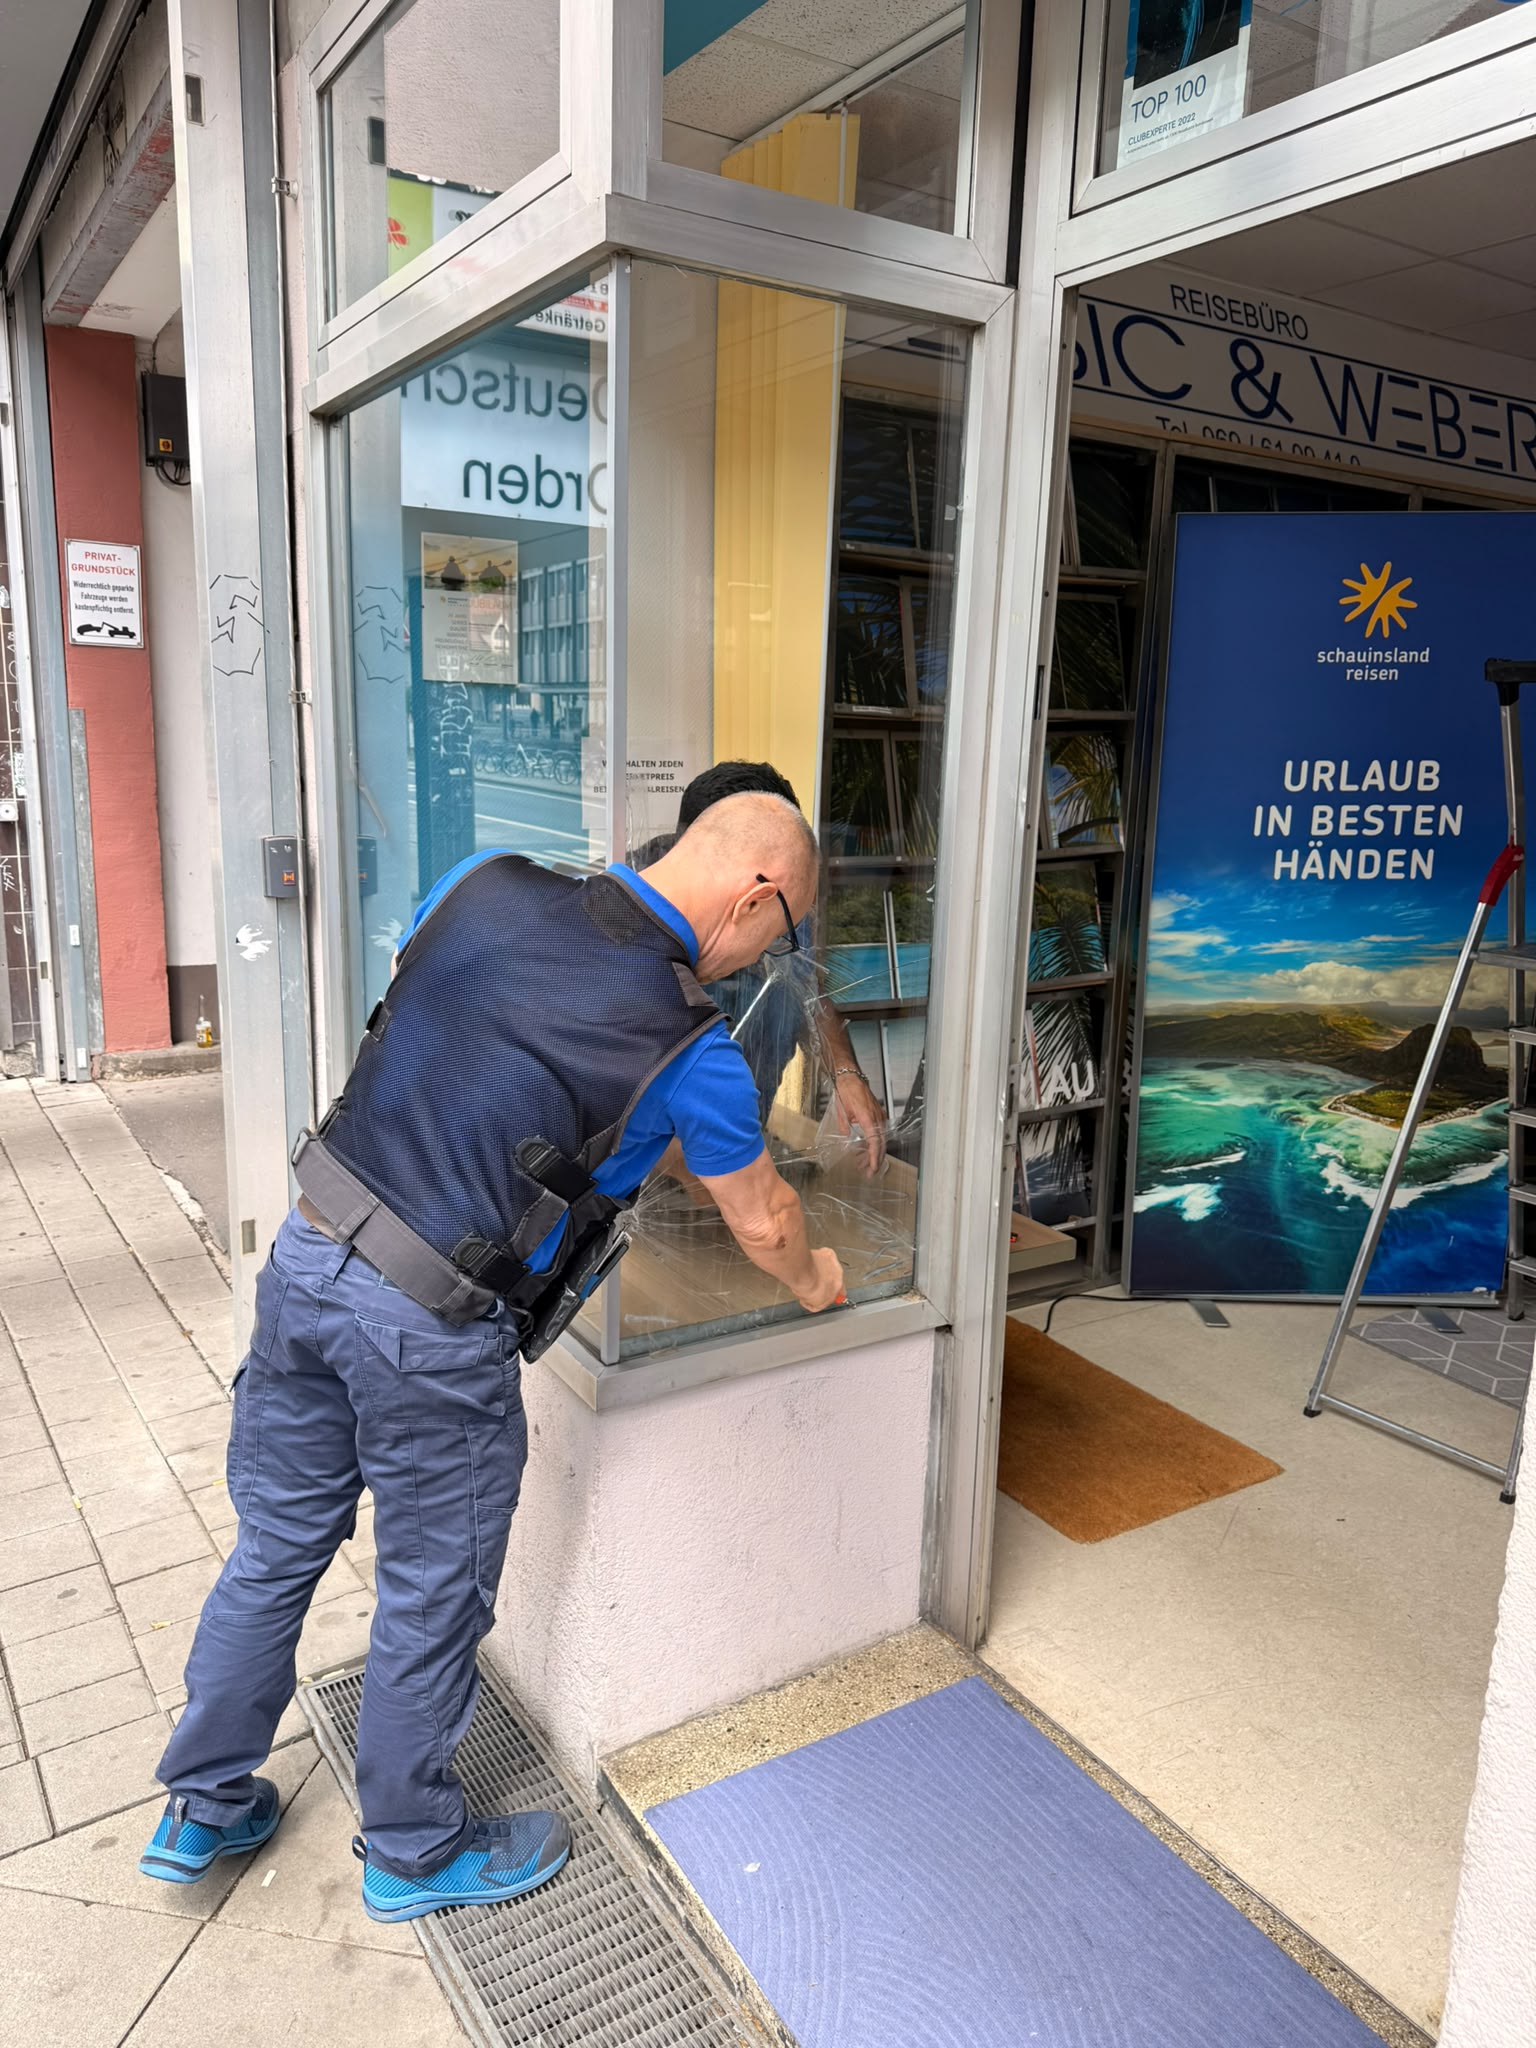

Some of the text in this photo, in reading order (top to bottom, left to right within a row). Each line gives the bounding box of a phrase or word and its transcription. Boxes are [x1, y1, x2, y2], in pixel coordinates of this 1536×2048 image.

[1131, 74, 1207, 123] TOP 100
[1128, 120, 1176, 146] CLUBEXPERTE
[1178, 112, 1196, 126] 2022
[1170, 284, 1309, 341] REISEBÜRO
[1073, 303, 1536, 473] IC & WEBER
[84, 551, 122, 562] PRIVAT-
[71, 563, 136, 577] GRUNDSTÜCK
[73, 580, 135, 593] Widerrechtlich geparkte
[81, 592, 129, 603] Fahrzeuge werden
[75, 602, 113, 614] kostenpflichtig
[1317, 647, 1430, 663] schauinsland
[1346, 665, 1399, 681] reisen
[626, 760, 684, 768] HALTEN JEDEN
[1283, 759, 1440, 792] URLAUB
[1253, 804, 1464, 837] IN BESTEN
[1273, 840, 1434, 881] HÄNDEN
